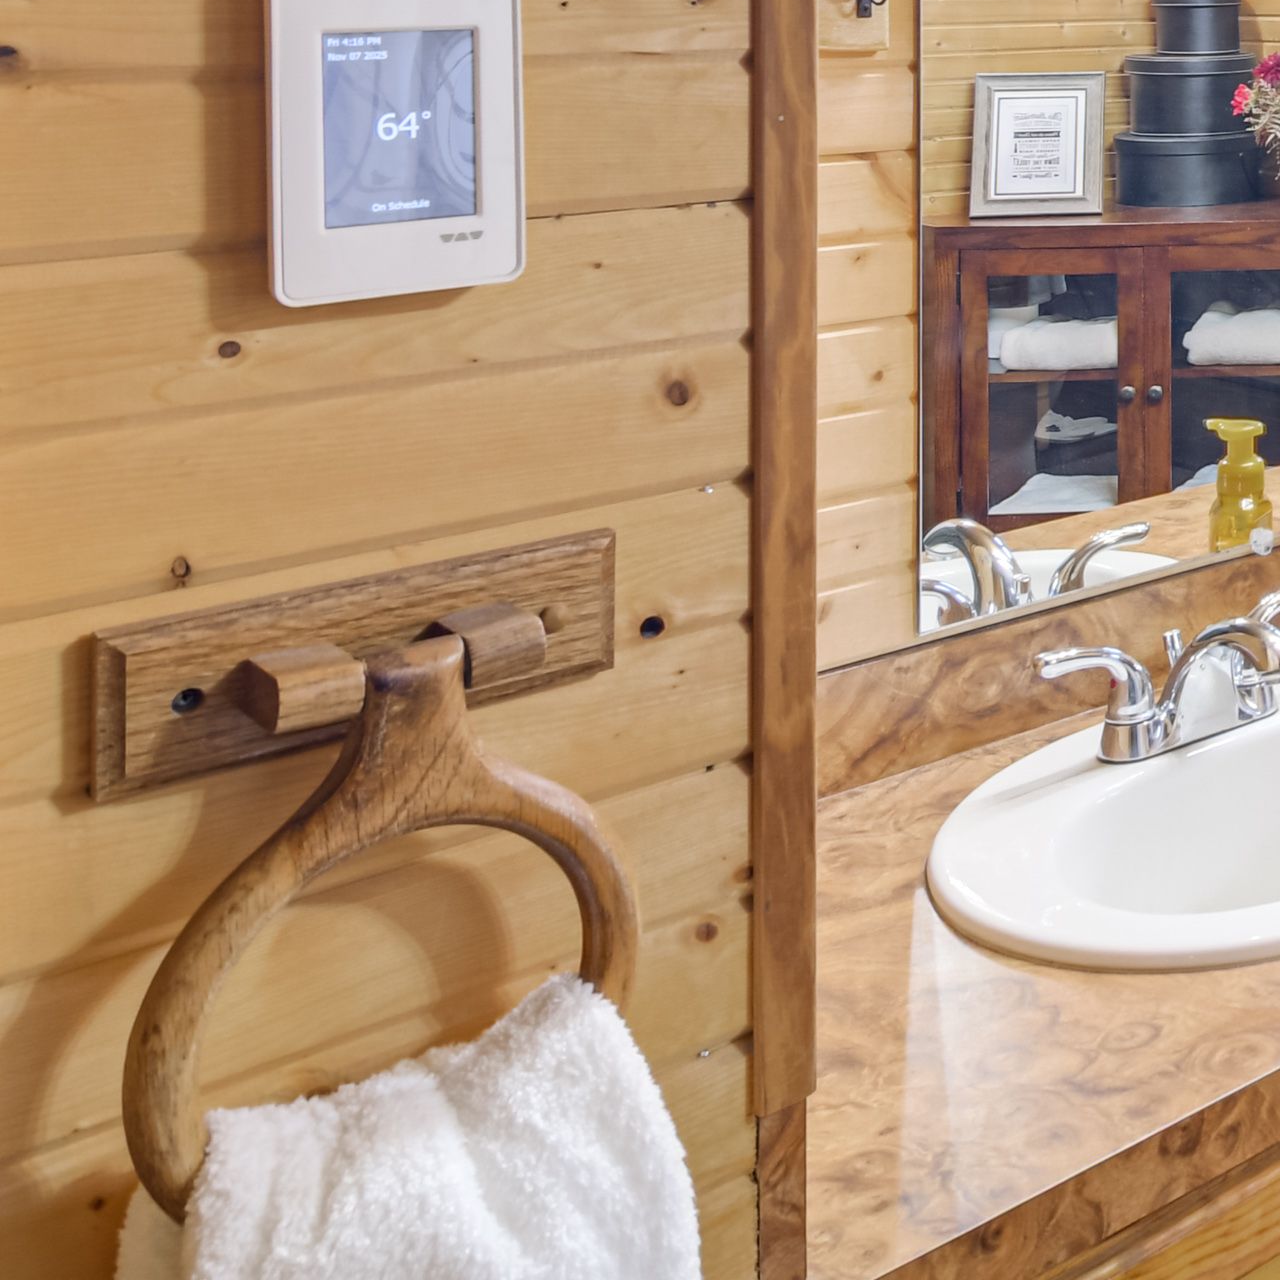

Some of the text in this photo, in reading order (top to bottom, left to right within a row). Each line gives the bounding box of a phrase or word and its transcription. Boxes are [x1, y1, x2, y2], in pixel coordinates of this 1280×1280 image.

[327, 37, 340, 47] Fri
[366, 36, 382, 46] PM
[327, 52, 347, 62] Nov
[371, 198, 431, 213] On Schedule
